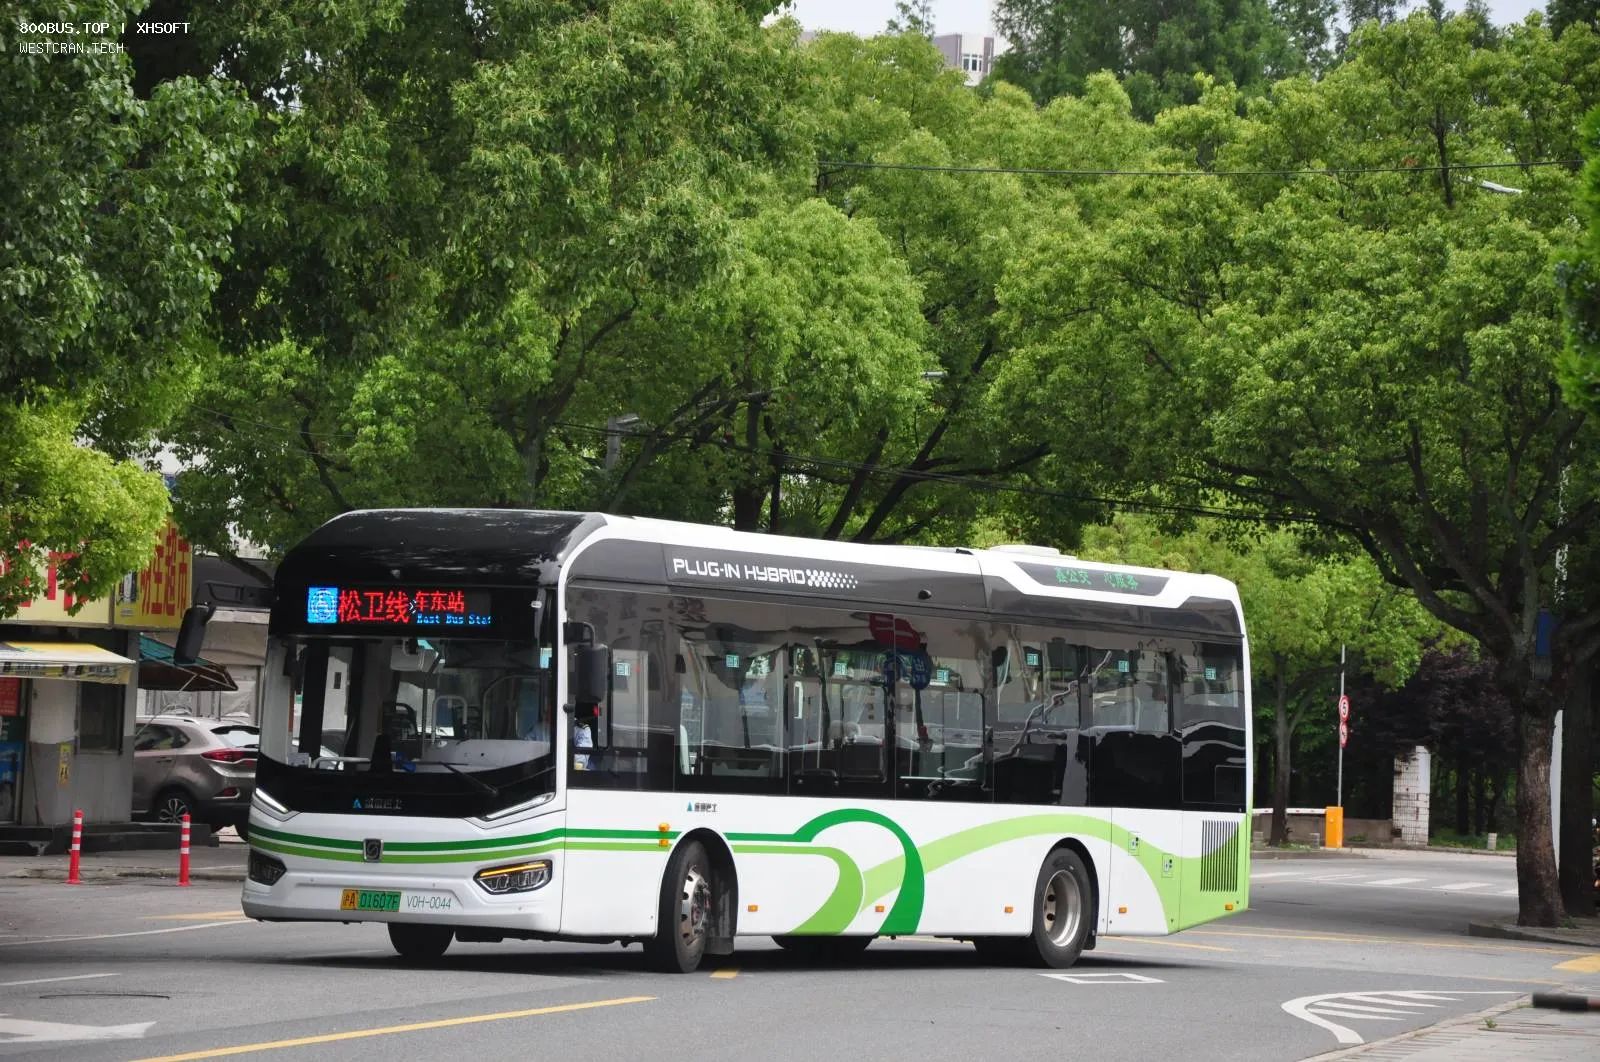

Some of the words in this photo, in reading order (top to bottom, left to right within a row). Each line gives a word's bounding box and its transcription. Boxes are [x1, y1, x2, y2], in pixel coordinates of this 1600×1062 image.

[672, 558, 741, 579] PLUG-IN
[744, 563, 806, 586] HYBRID
[338, 590, 410, 623] 松卫线
[416, 613, 440, 624] East
[445, 613, 464, 624] Bus
